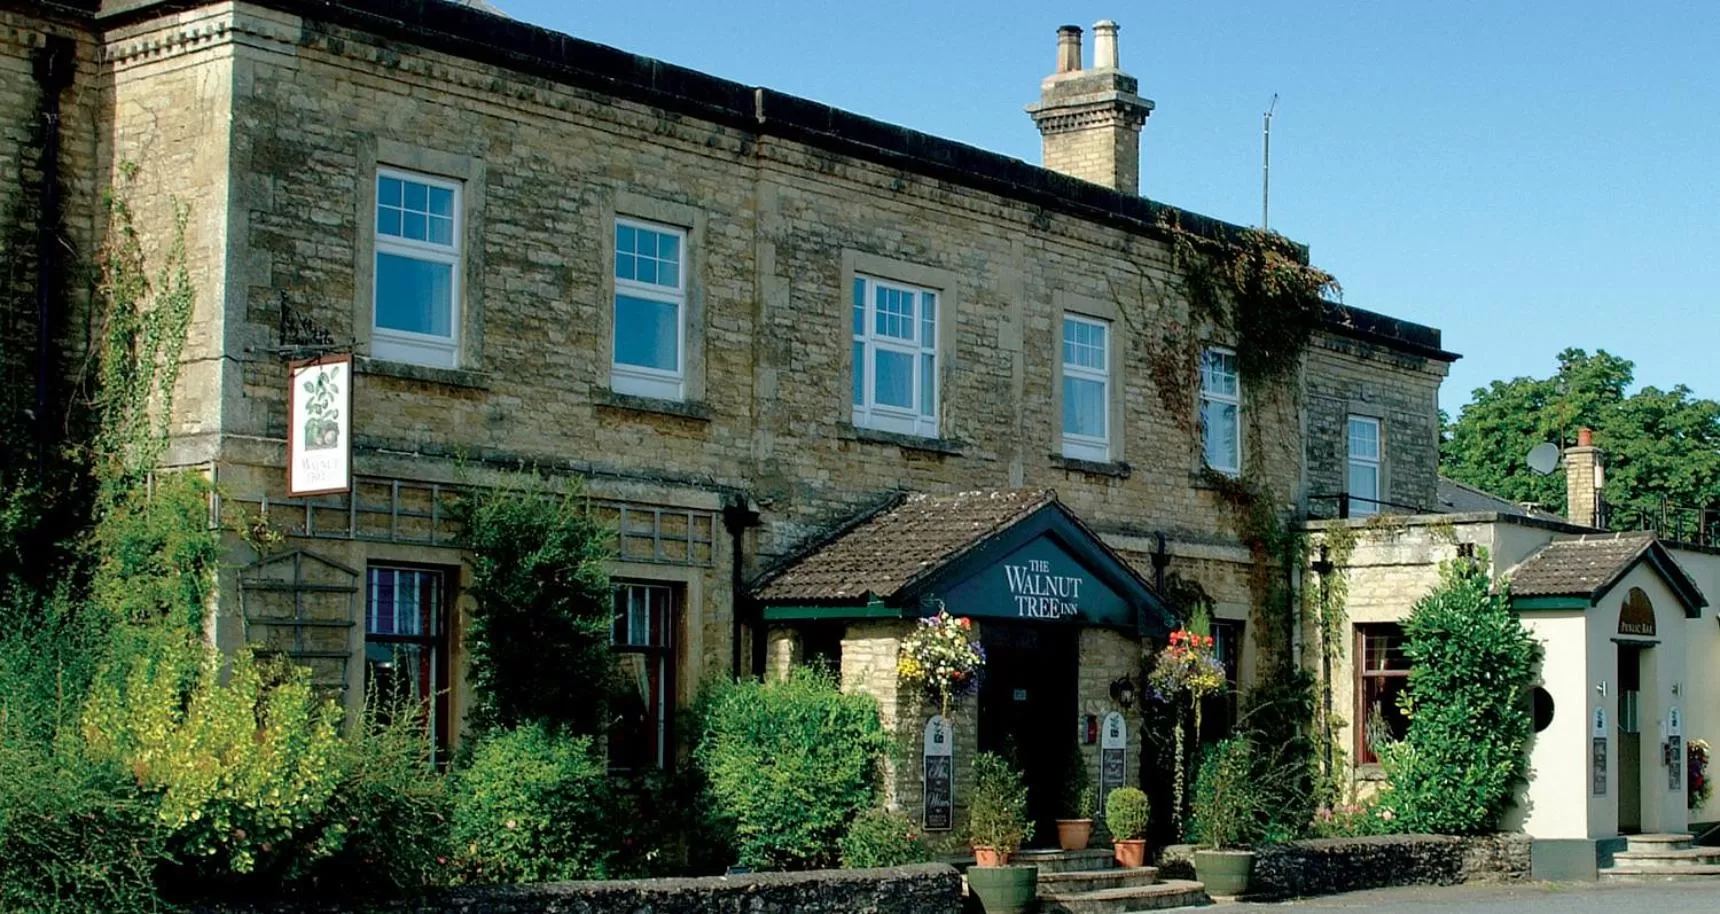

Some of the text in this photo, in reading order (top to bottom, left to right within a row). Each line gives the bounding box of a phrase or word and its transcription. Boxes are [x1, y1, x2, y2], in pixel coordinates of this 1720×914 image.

[1028, 560, 1050, 573] THE
[1004, 565, 1083, 598] WALNUT
[1015, 596, 1078, 619] TREE INN
